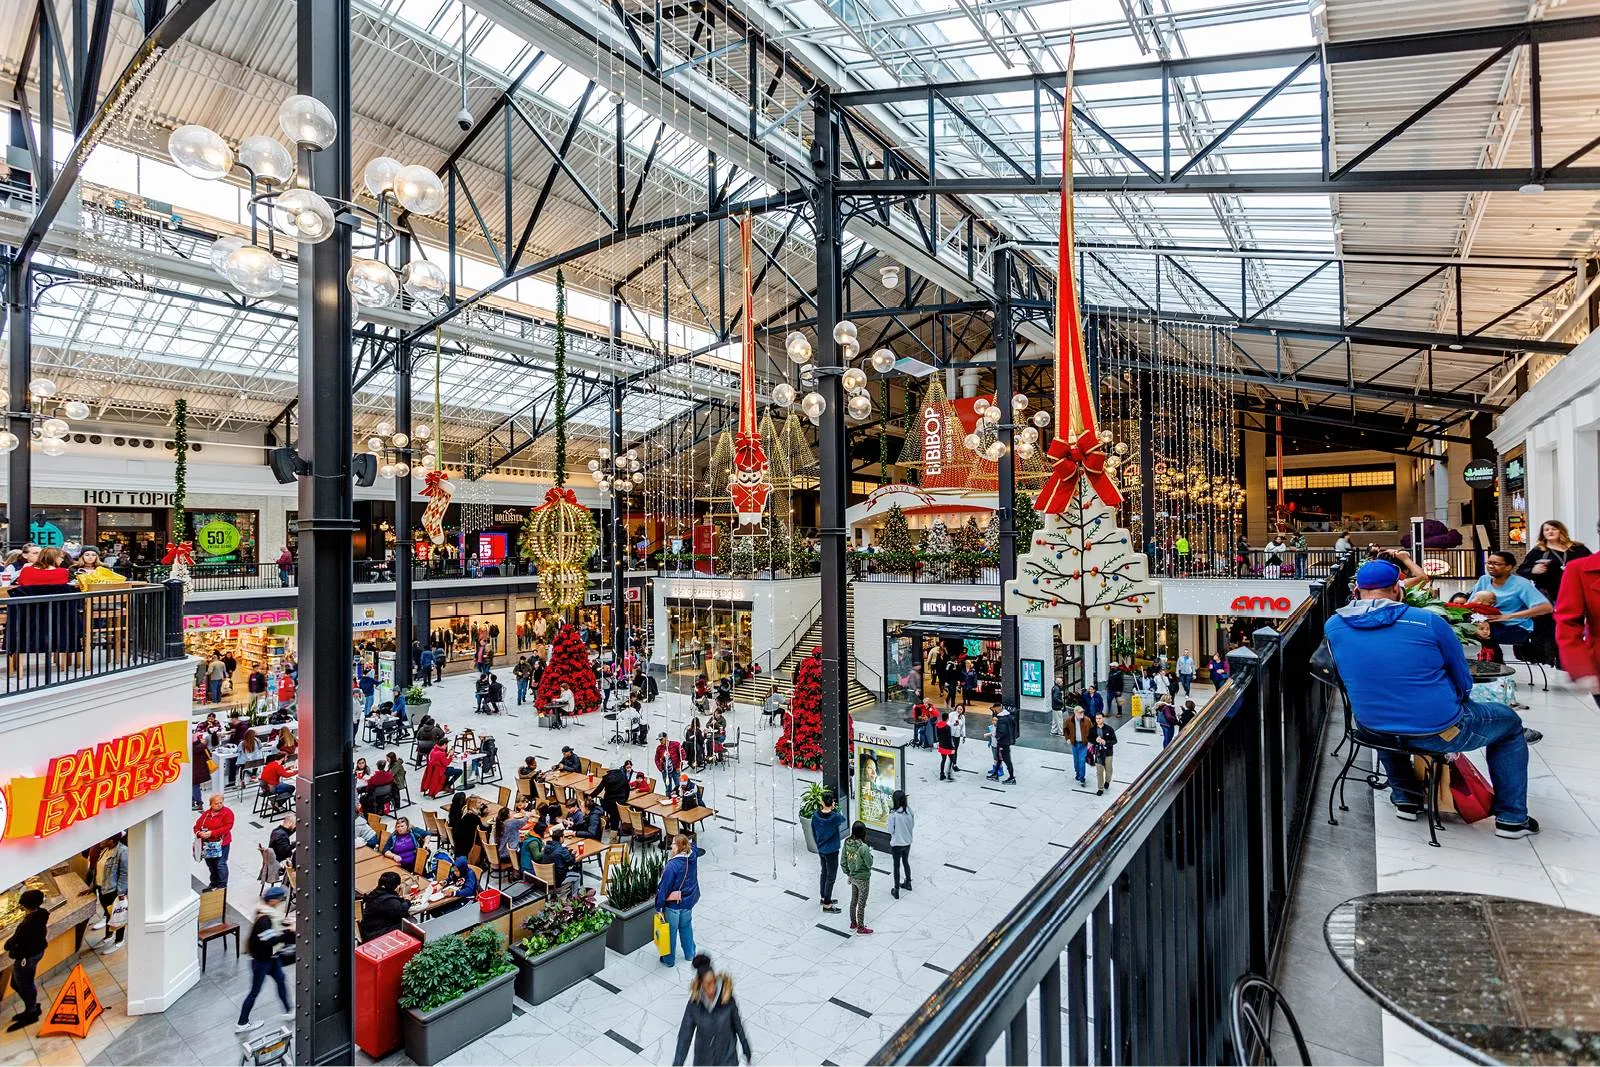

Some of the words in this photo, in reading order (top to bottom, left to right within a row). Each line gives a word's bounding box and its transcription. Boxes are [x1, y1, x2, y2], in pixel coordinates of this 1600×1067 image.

[884, 485, 910, 493] SANTA
[84, 490, 124, 505] HOT
[494, 513, 524, 522] HOLLISTER
[30, 531, 57, 545] REE
[951, 604, 976, 613] SOCKS
[182, 610, 292, 630] IT'SUGAR
[858, 732, 892, 746] EASTON
[43, 725, 167, 799] PANDA
[35, 751, 183, 838] EXPRESS
